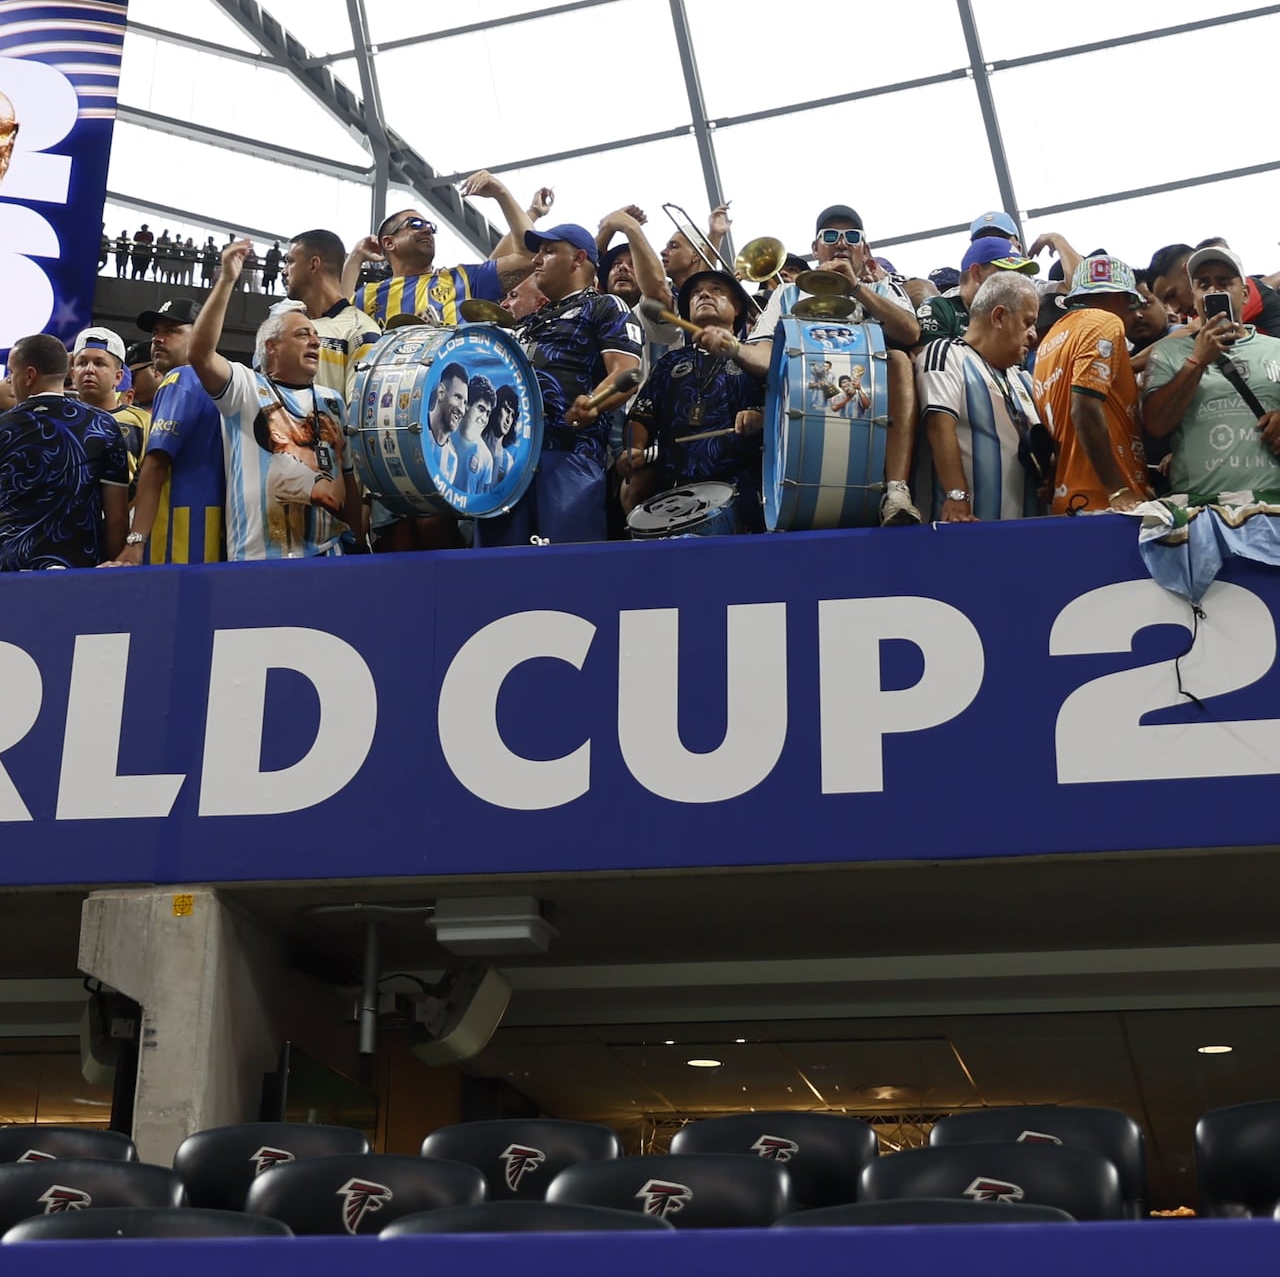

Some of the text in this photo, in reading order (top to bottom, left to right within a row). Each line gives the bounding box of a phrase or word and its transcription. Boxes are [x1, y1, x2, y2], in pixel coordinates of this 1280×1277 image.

[437, 334, 465, 360] LOS
[469, 331, 491, 347] SIN
[433, 473, 468, 509] MIAMI
[437, 596, 985, 810] CUP
